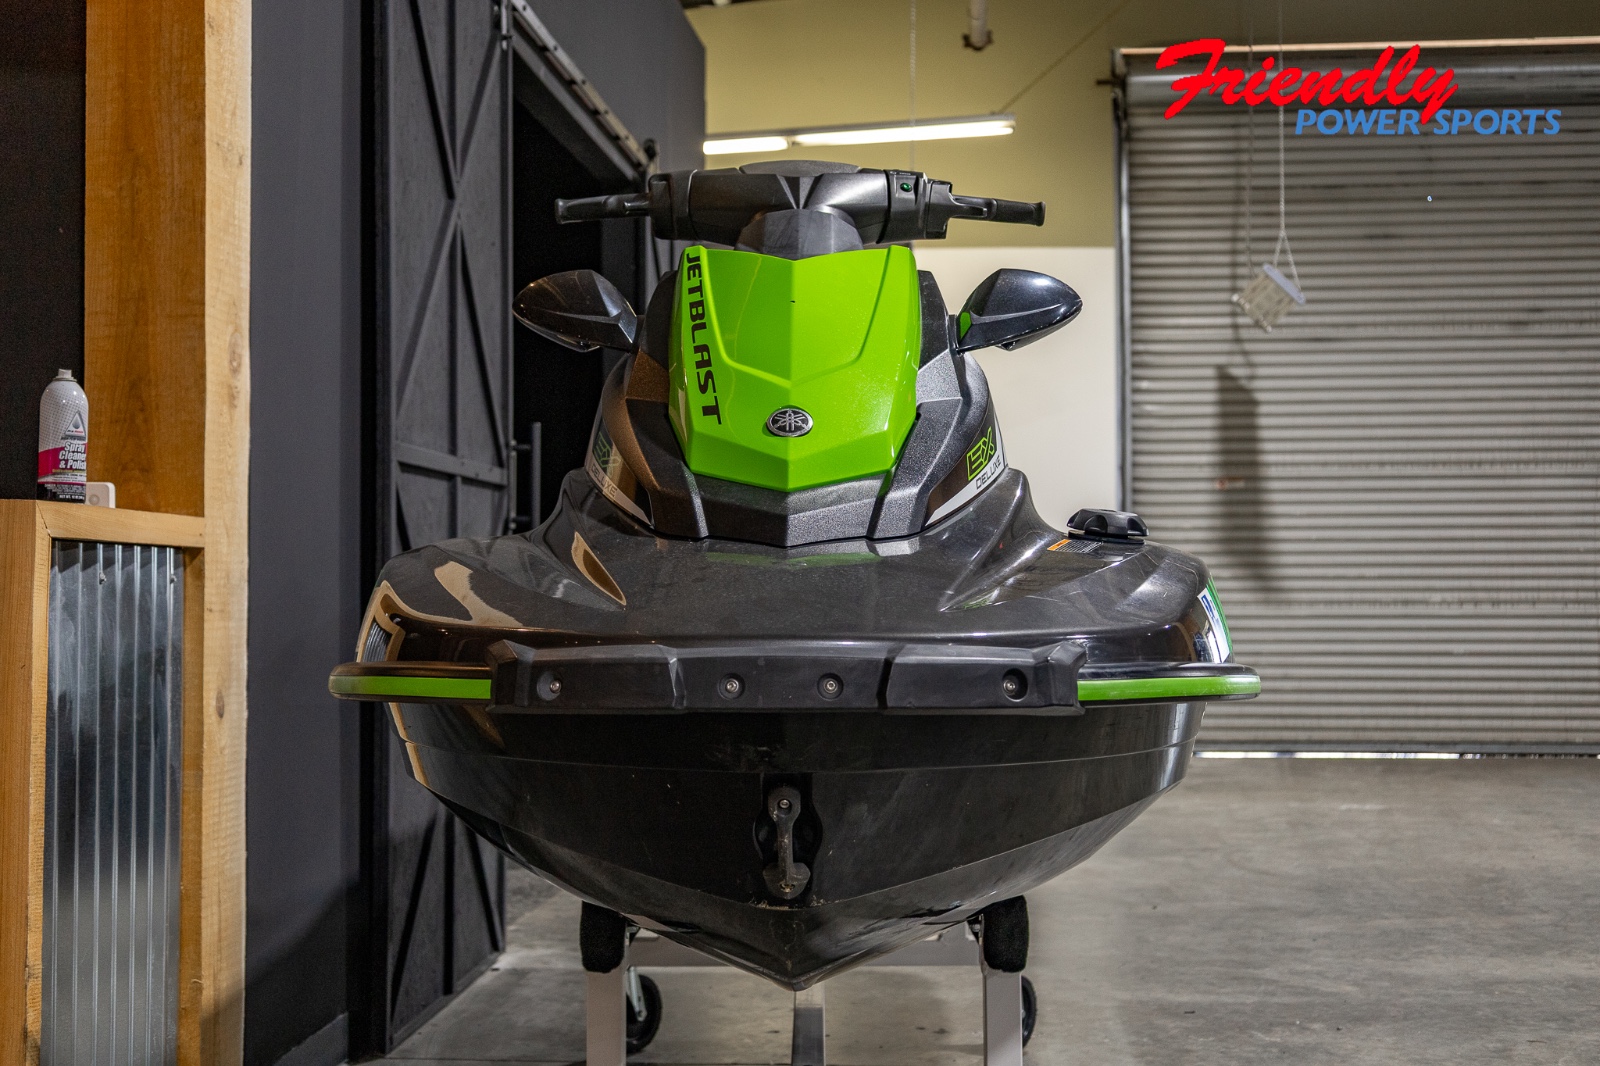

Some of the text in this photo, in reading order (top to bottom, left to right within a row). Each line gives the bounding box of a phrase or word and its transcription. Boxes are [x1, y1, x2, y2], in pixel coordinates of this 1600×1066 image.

[686, 252, 722, 425] JETBLAST
[59, 451, 86, 461] Cleane
[59, 460, 66, 469] &
[65, 442, 85, 453] Spray
[966, 426, 995, 481] EX
[591, 462, 618, 498] DELUXE
[975, 454, 1002, 490] DELUXE
